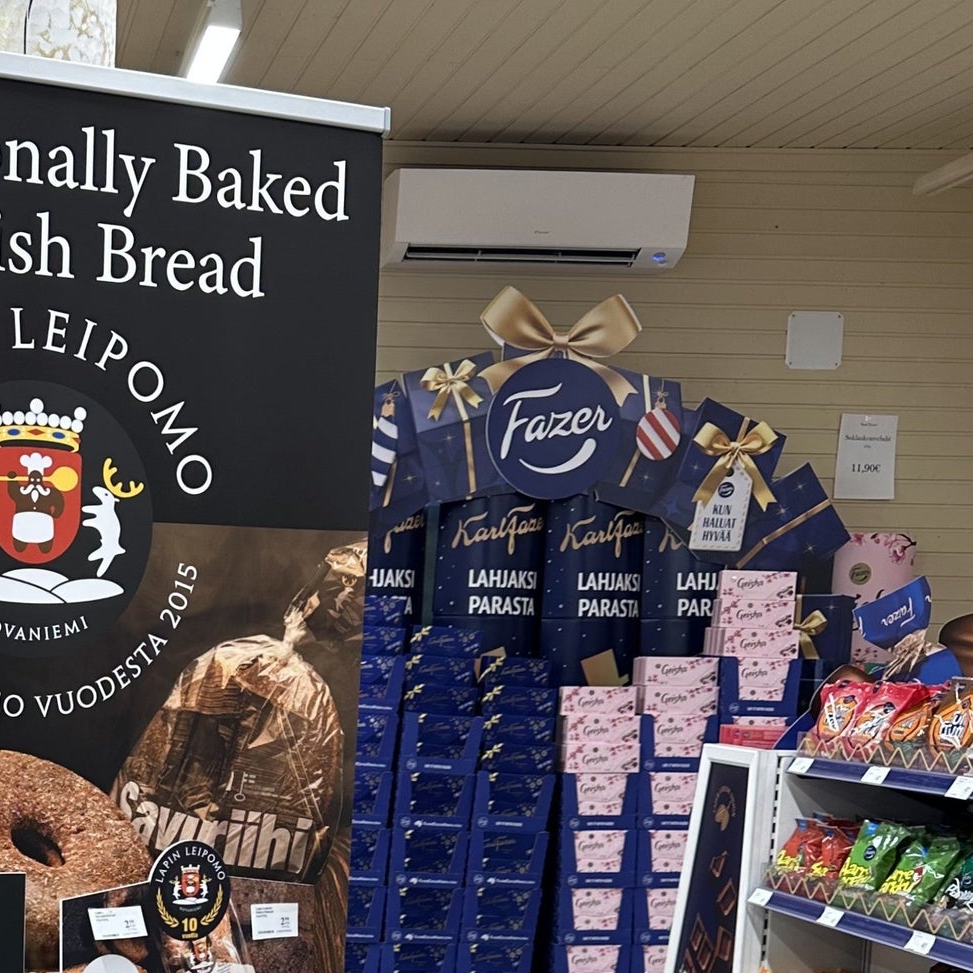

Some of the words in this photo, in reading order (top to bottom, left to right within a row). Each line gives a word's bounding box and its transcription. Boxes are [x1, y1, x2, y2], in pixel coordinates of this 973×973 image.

[171, 143, 350, 222] Baked
[96, 222, 266, 299] Bread
[9, 306, 213, 496] LEIPOMO
[500, 381, 613, 460] Fazer
[851, 463, 882, 474] 11,90€
[368, 568, 416, 589] HJAKSI
[468, 568, 538, 590] LAHJAKSI
[577, 572, 641, 591] LAHJAKSI
[736, 577, 764, 590] Geisha
[468, 595, 535, 616] PARASTA
[577, 598, 640, 618] PARASTA
[736, 609, 763, 622] Geisha
[33, 634, 168, 719] VUODESTA
[159, 562, 198, 630] 2015
[740, 638, 767, 650] Geisha
[661, 663, 688, 676] Geisha
[741, 667, 768, 679] Geisha
[578, 696, 605, 709] Geisha
[661, 692, 688, 705] Geisha
[583, 725, 609, 738] Geisha
[656, 723, 684, 736] Geisha
[582, 753, 609, 766] Geisha
[155, 850, 181, 884] LAPIN
[185, 846, 226, 881] LEIPOMO
[182, 917, 198, 932] 10
